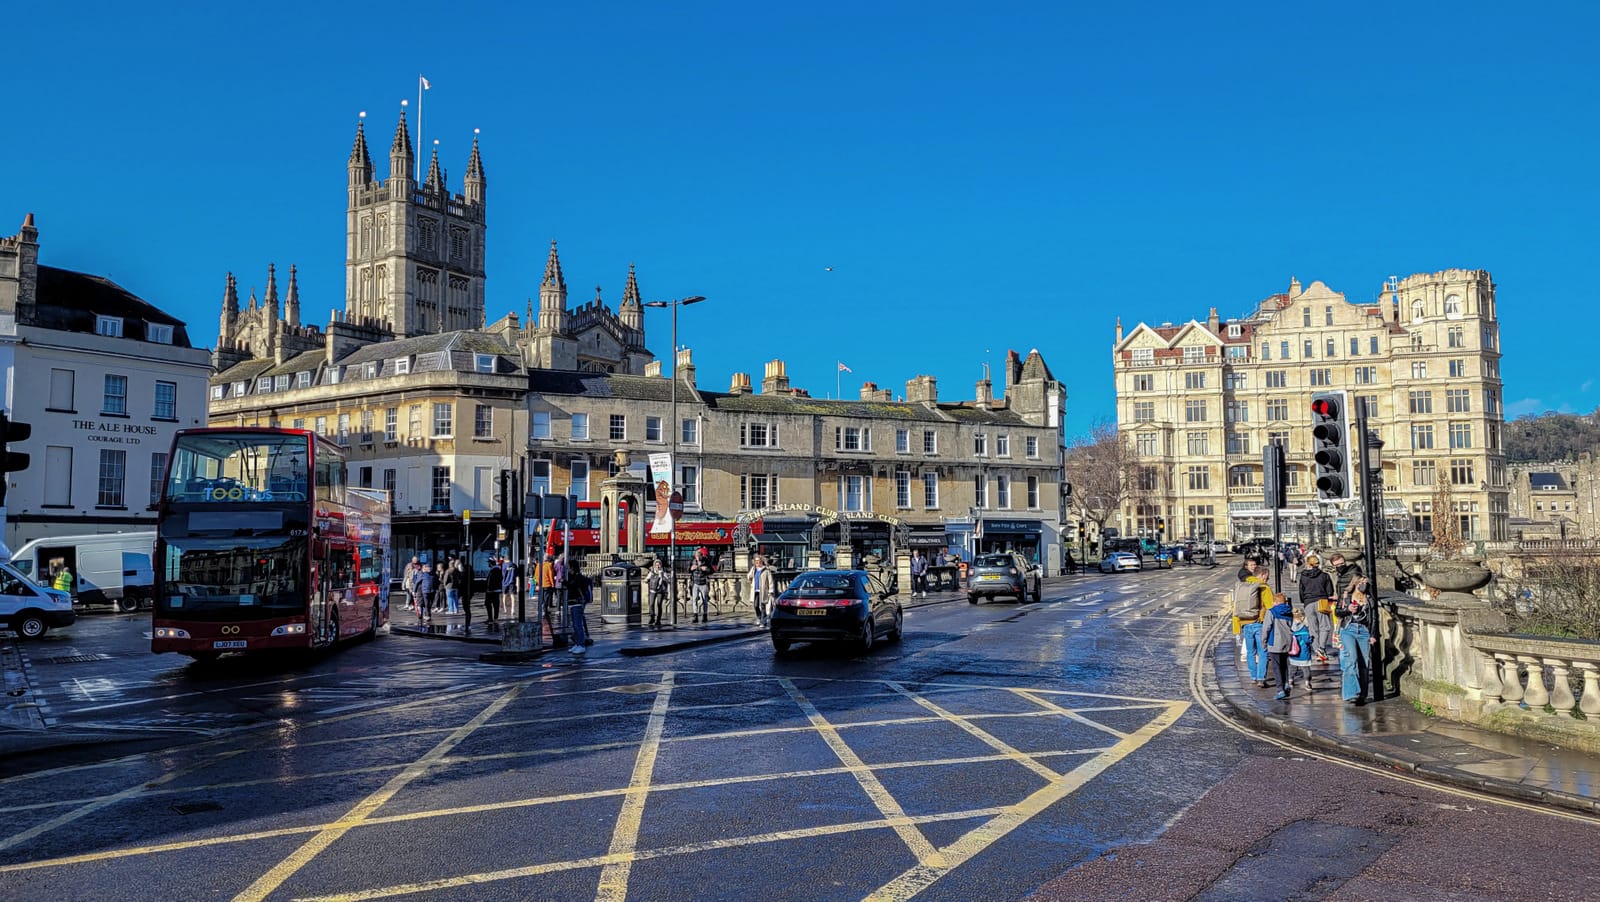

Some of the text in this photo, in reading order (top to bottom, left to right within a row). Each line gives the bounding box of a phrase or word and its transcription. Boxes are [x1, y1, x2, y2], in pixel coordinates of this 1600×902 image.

[72, 420, 157, 435] THE ALE HOUSE
[88, 435, 124, 444] COURAGE
[748, 503, 838, 520] THE ISLAND CLUB
[820, 518, 836, 527] THE
[879, 514, 899, 526] CLUB
